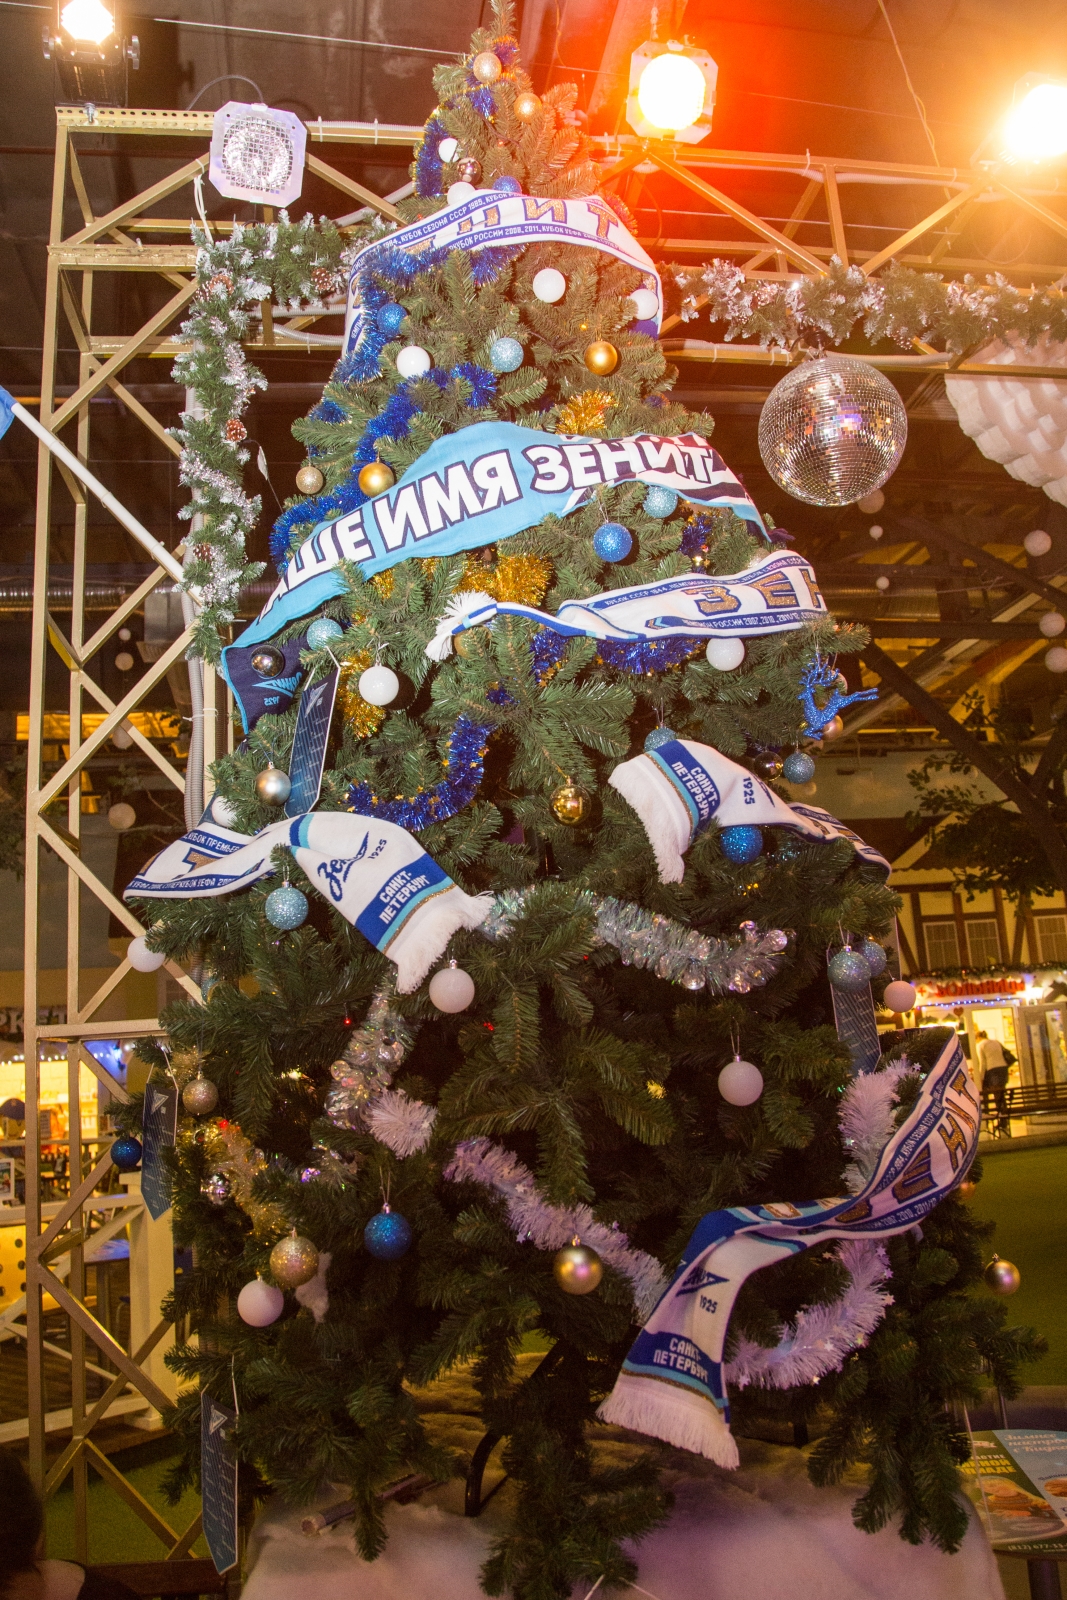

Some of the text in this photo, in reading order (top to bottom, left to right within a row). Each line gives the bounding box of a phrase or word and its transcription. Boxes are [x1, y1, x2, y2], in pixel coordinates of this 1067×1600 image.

[400, 229, 423, 243] КУБОК
[422, 217, 448, 234] СЕЗОНА
[449, 208, 467, 221] СССР
[485, 192, 508, 204] КУБОК
[448, 237, 474, 251] РКУБОК
[473, 229, 504, 243] РОССИИ
[524, 225, 542, 234] 2011,
[542, 225, 564, 235] КУБОК
[371, 448, 524, 552] ИМЯ
[521, 441, 712, 493] ЗЕНИТ
[712, 618, 745, 629] РОССИИ
[742, 776, 756, 805] 1925
[367, 838, 388, 860] 1925
[378, 874, 431, 924] ПЕТЕРБУРГ
[379, 869, 412, 904] САНКТ-
